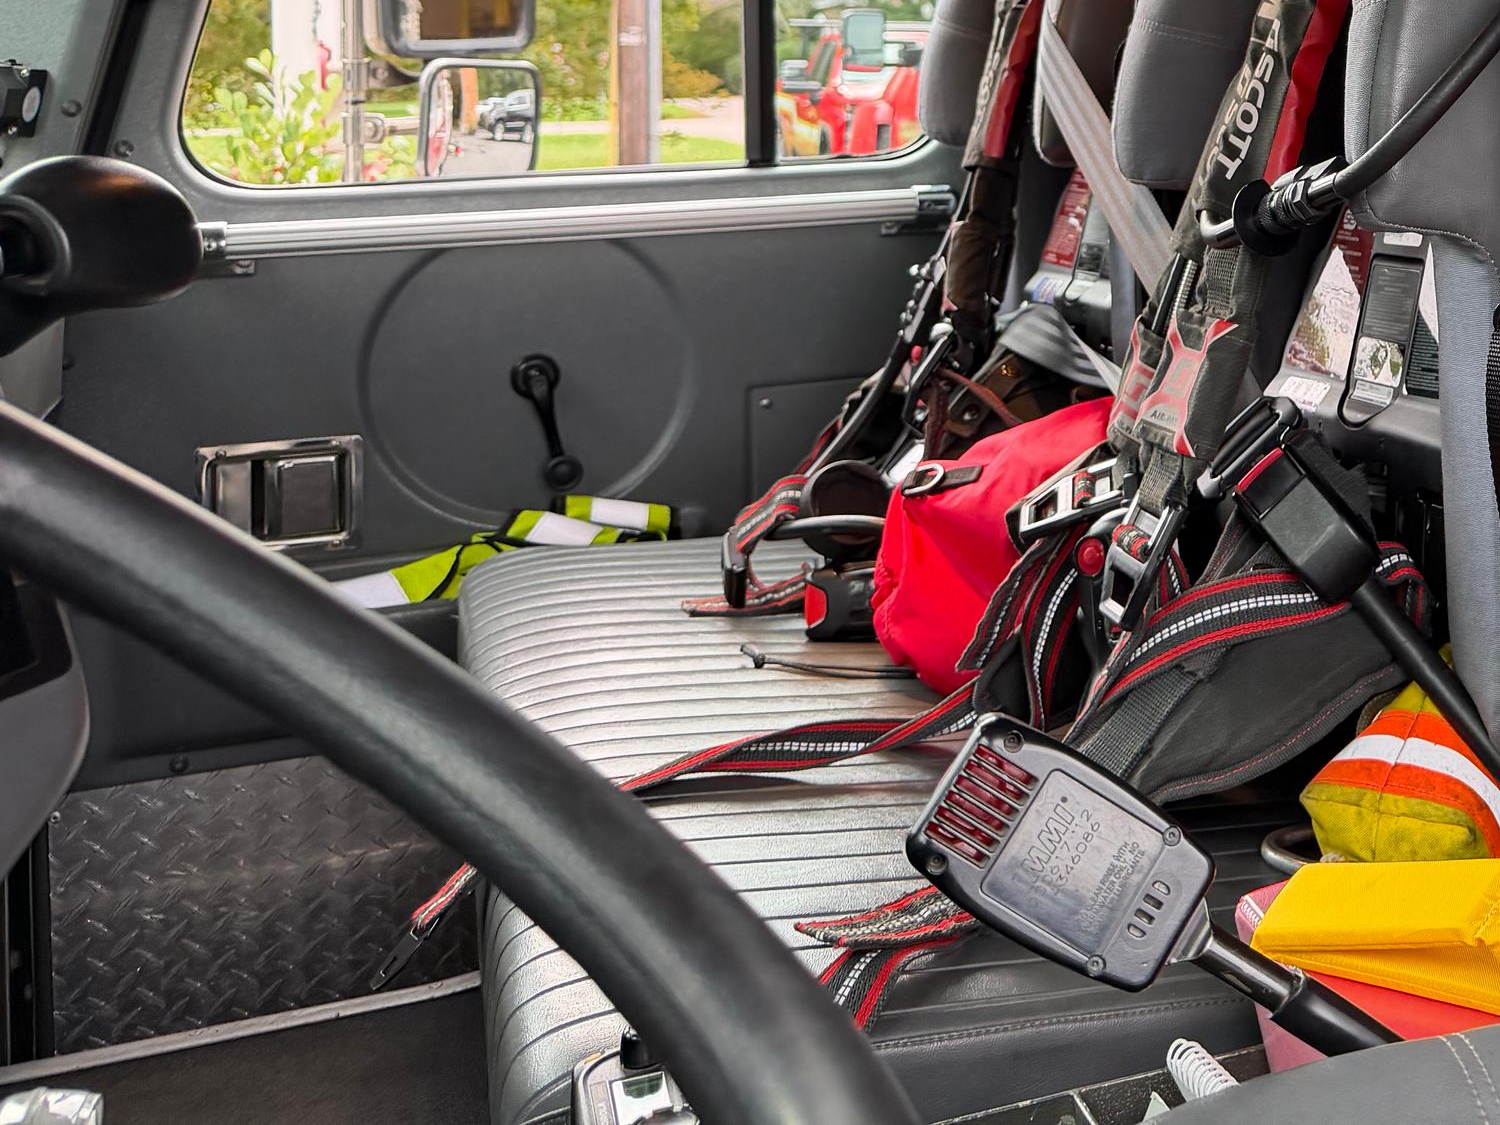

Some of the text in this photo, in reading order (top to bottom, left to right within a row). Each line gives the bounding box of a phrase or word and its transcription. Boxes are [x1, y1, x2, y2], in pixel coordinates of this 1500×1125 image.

[1214, 50, 1275, 181] SCOTT
[1095, 879, 1118, 909] WATER
[1128, 841, 1140, 855] NO
[1099, 861, 1118, 886] RINSE
[1112, 841, 1130, 862] WITH
